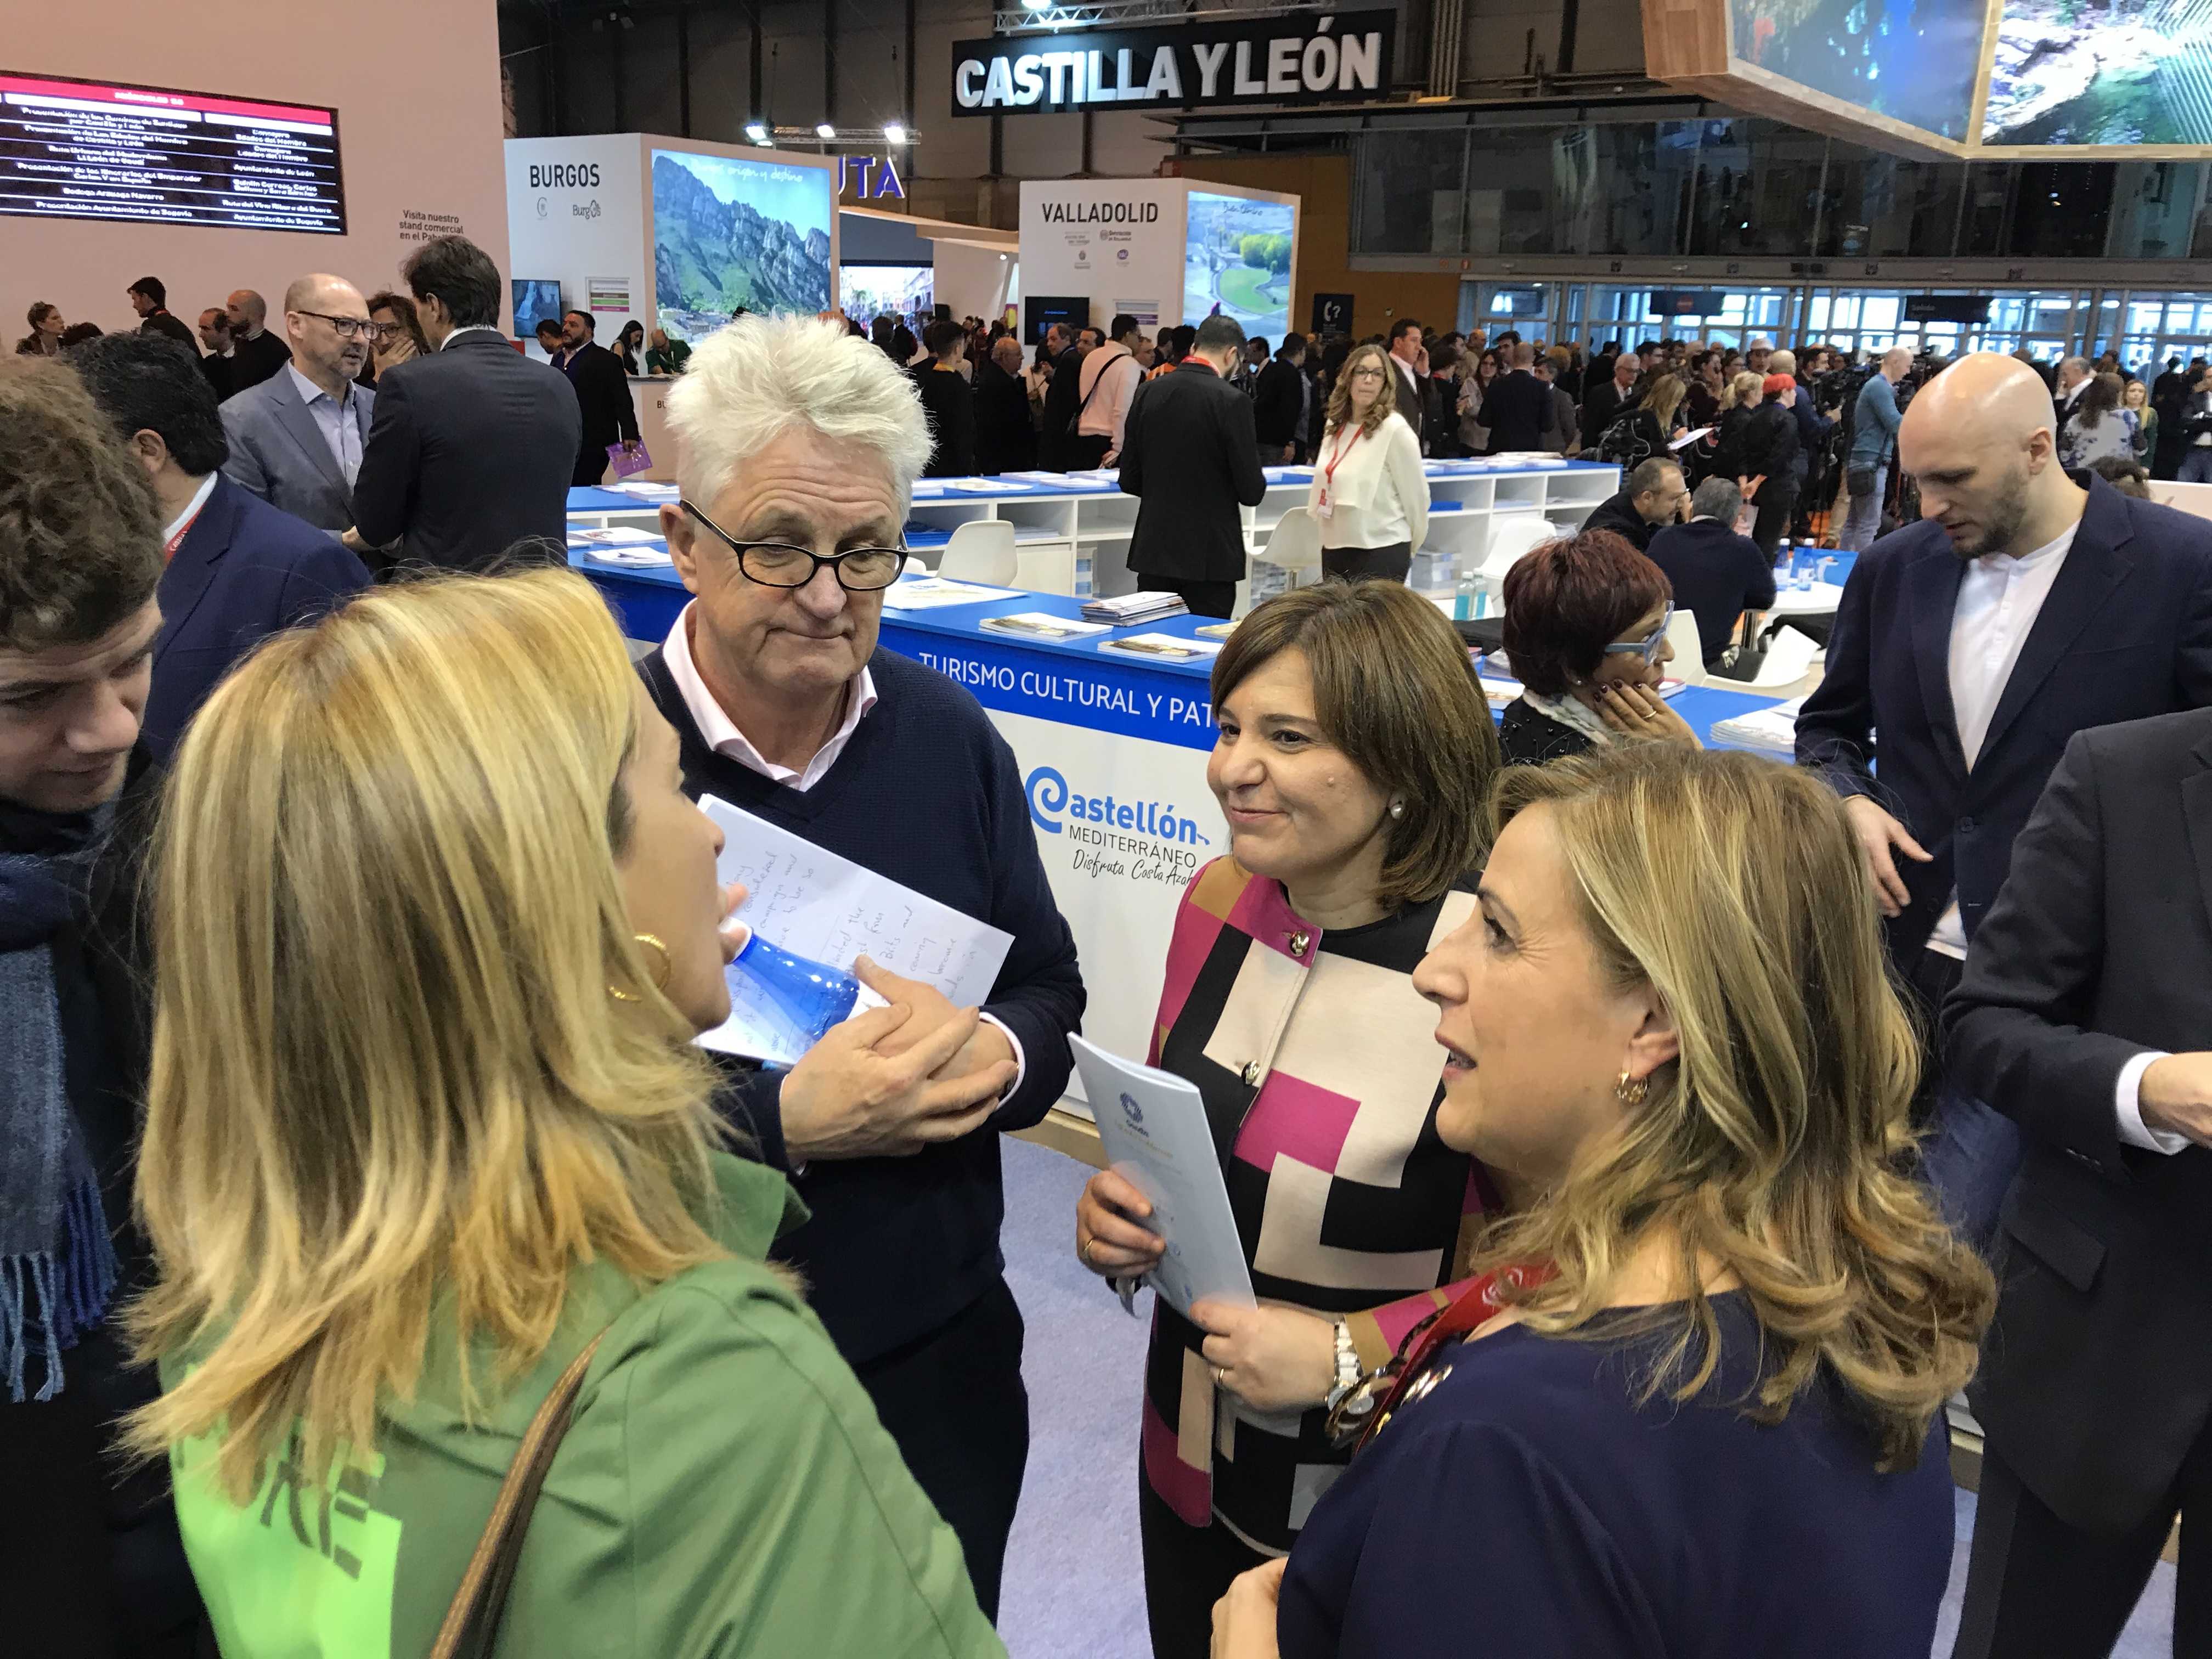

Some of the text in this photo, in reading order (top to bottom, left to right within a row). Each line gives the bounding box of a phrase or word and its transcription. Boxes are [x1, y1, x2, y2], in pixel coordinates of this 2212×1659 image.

[956, 16, 1382, 108] CASTILLA Y LEÓN
[530, 163, 600, 188] BURGOS
[770, 167, 803, 182] destino
[36, 201, 92, 211] Presentación
[131, 193, 164, 201] Navarro
[403, 210, 459, 223] Visita nuestro
[1042, 202, 1158, 223] VALLADOLID
[399, 221, 464, 234] stand comercial
[412, 232, 420, 240] el
[919, 652, 1014, 691] TURISMO
[1022, 672, 1141, 715] CULTURAL
[1147, 693, 1163, 718] Y
[1025, 766, 1197, 845] Castellón
[1070, 825, 1196, 868] MEDITERRÁNEO
[1073, 849, 1124, 878] Disfruta
[1131, 859, 1164, 881] Costa
